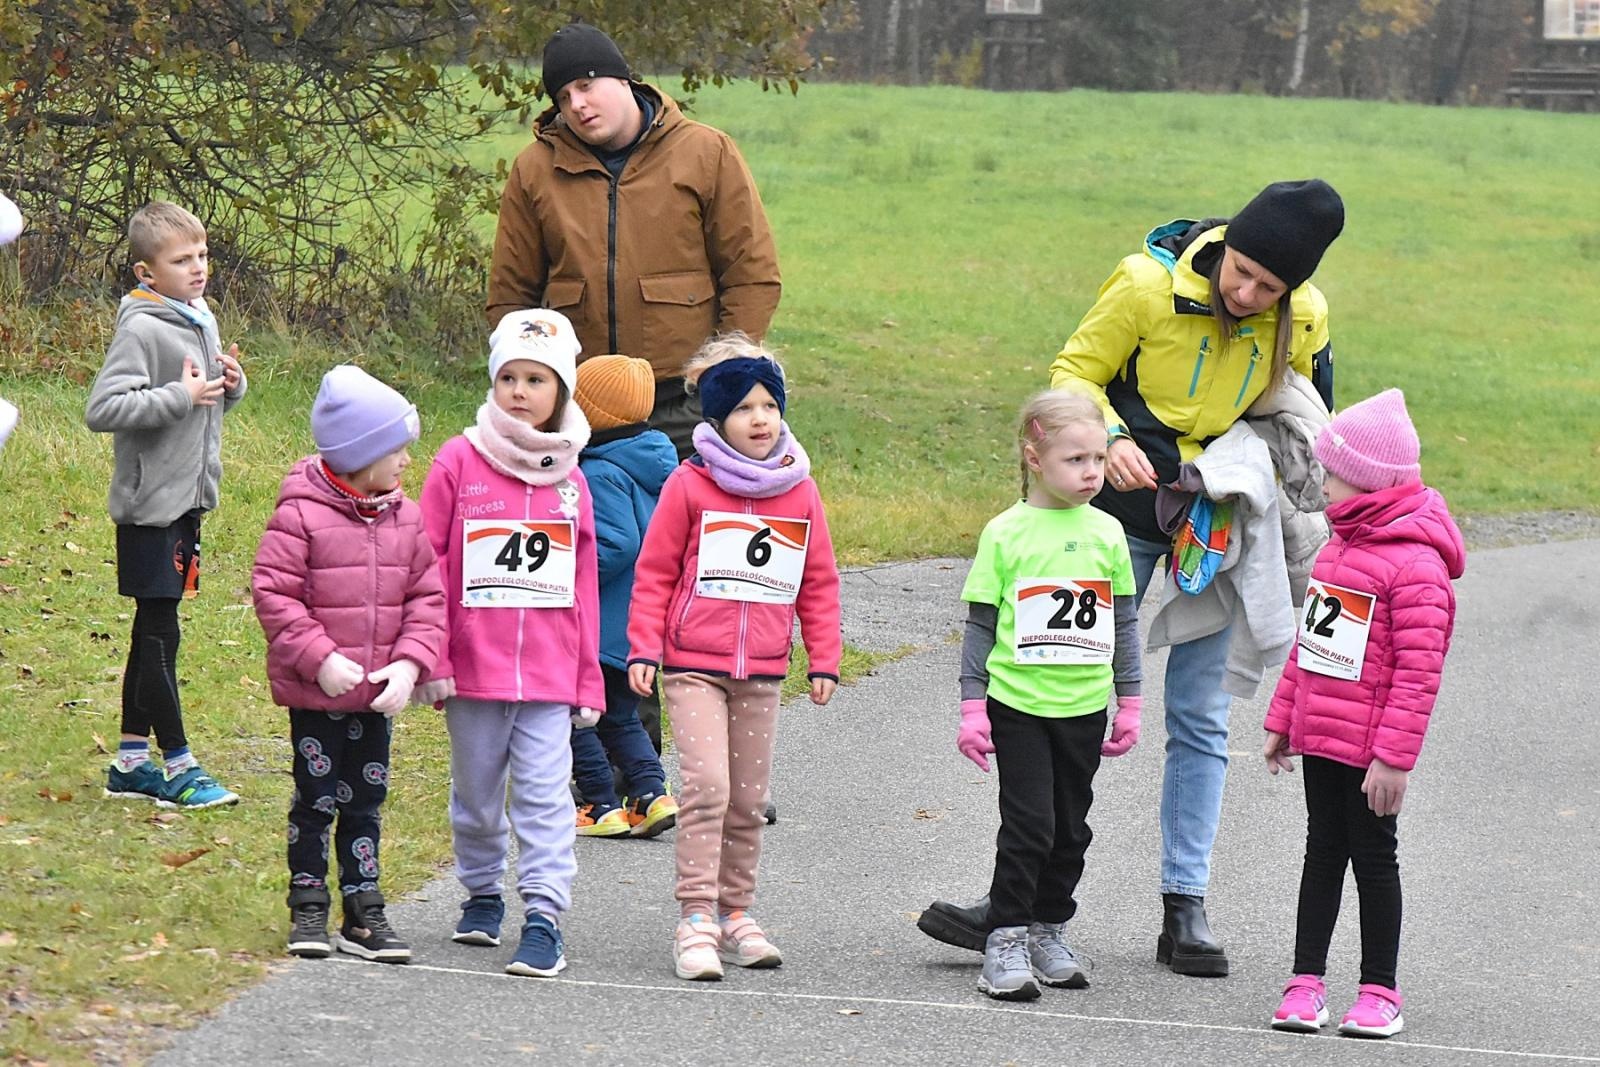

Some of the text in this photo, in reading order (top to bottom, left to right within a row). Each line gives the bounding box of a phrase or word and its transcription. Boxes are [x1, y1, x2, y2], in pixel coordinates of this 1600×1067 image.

[458, 483, 489, 497] Little
[494, 531, 550, 573] 49
[746, 527, 772, 567] 6
[704, 569, 779, 586] NIEPODLEGŁOŚCIOWA
[1047, 588, 1097, 630] 28
[1305, 592, 1341, 638] 42
[1021, 634, 1096, 647] NIEPODLEGŁOŚCIOWA
